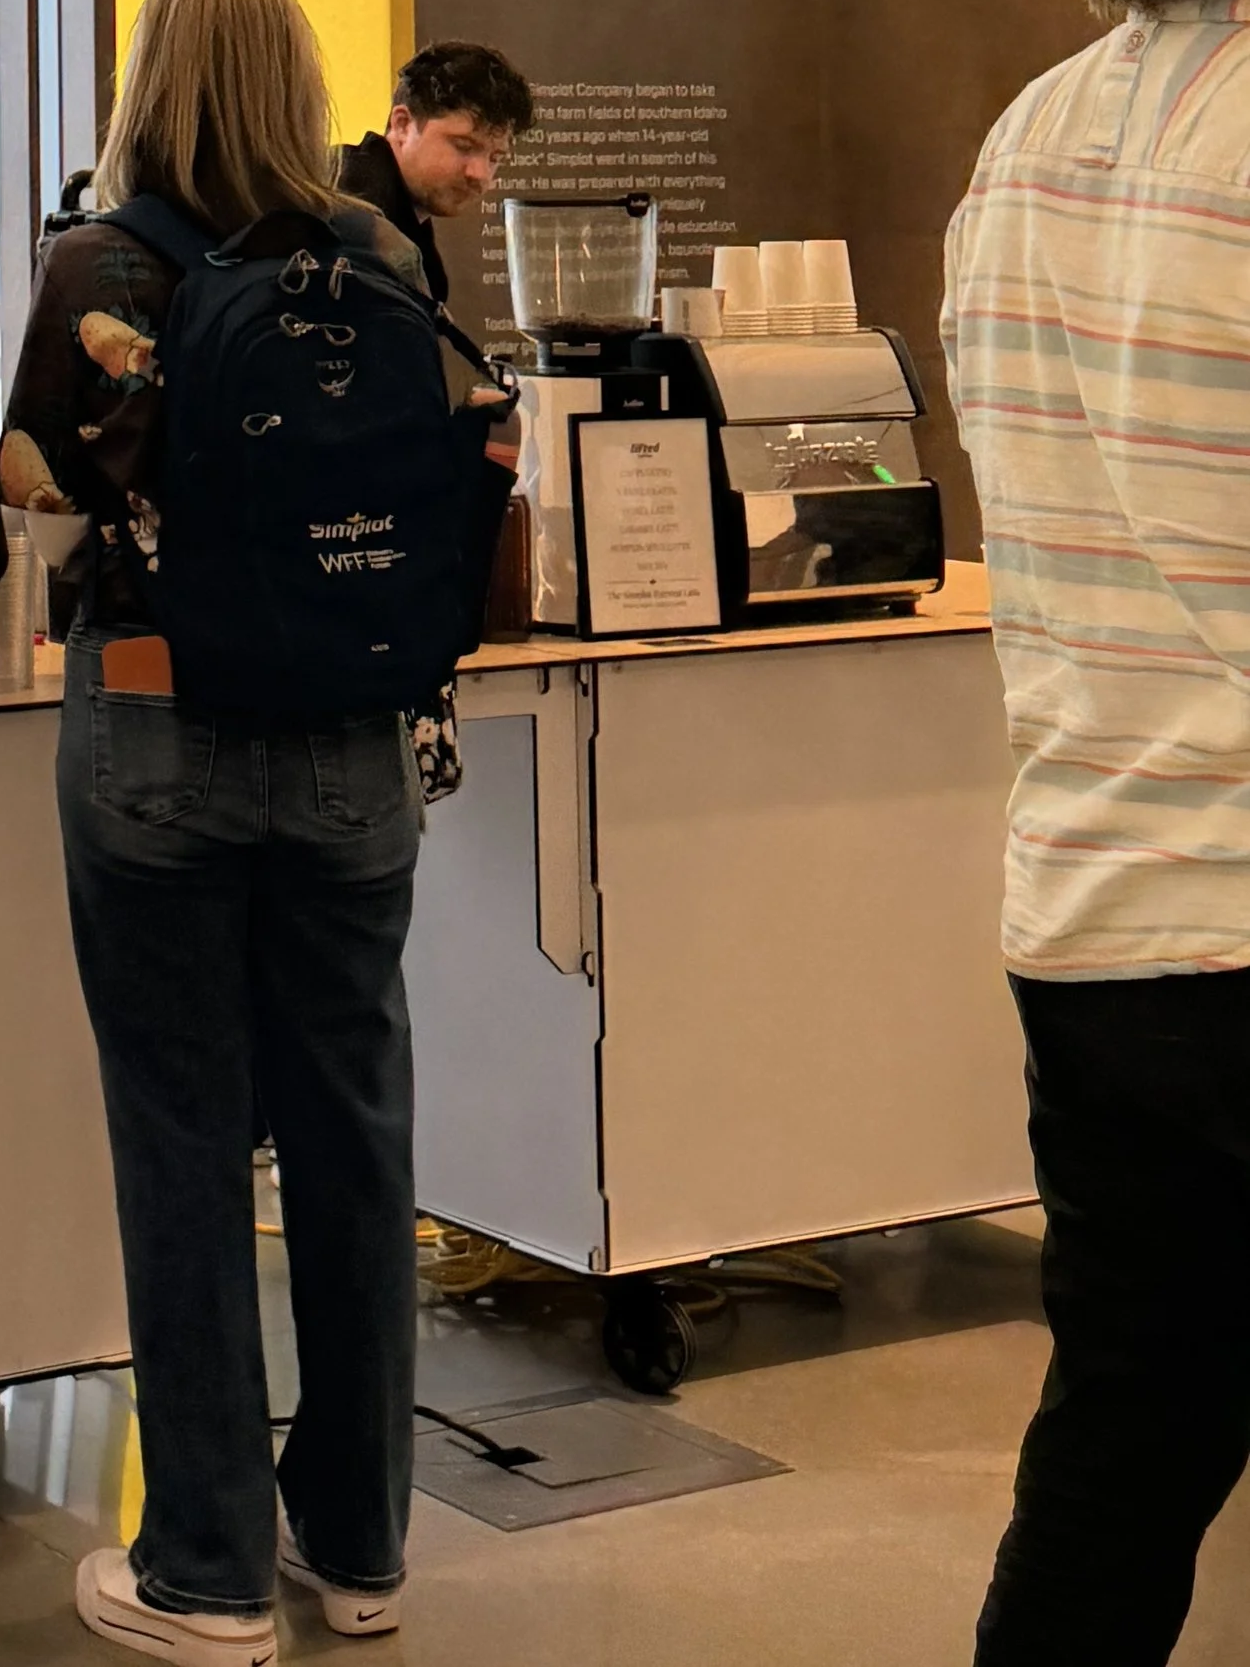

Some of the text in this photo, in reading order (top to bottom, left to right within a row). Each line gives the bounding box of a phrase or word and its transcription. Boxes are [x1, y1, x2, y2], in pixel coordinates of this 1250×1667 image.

[576, 83, 633, 99] Company
[635, 83, 673, 99] began
[675, 85, 688, 97] to
[690, 83, 716, 97] take
[557, 106, 586, 119] farm
[588, 106, 622, 120] fields
[623, 106, 636, 119] of
[637, 106, 692, 120] southern
[693, 106, 728, 120] Idaho
[546, 130, 580, 145] years
[582, 131, 606, 145] ago
[608, 130, 640, 142] when
[642, 128, 709, 144] 14-year-old
[546, 152, 593, 167] Simplot
[595, 153, 625, 165] went
[627, 153, 639, 165] in
[641, 152, 682, 165] search
[684, 152, 696, 165] of
[698, 152, 718, 165] his
[532, 177, 550, 189] He
[551, 178, 576, 189] was
[578, 176, 633, 191] prepared
[635, 175, 661, 188] with
[662, 175, 726, 190] everything
[481, 201, 498, 214] he
[308, 513, 394, 542] Simplot
